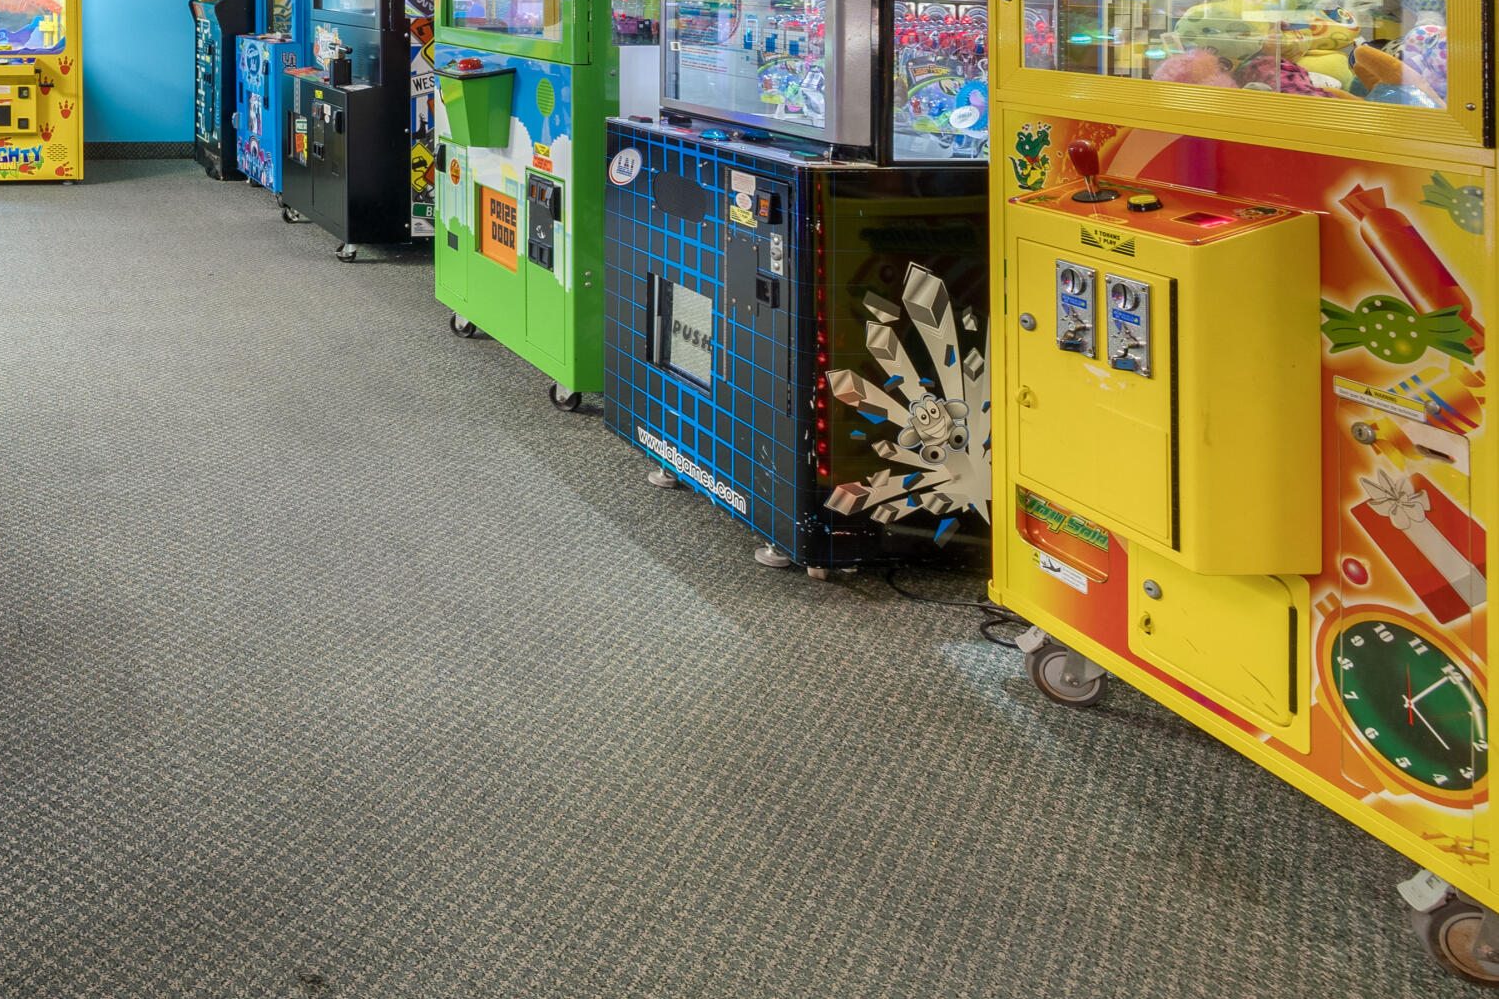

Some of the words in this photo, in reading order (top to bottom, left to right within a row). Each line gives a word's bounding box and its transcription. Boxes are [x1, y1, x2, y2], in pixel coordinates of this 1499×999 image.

[491, 198, 516, 228] PRIZE
[492, 221, 516, 251] DOOR
[672, 319, 712, 352] PUSH
[637, 426, 747, 515] www.laigames.com
